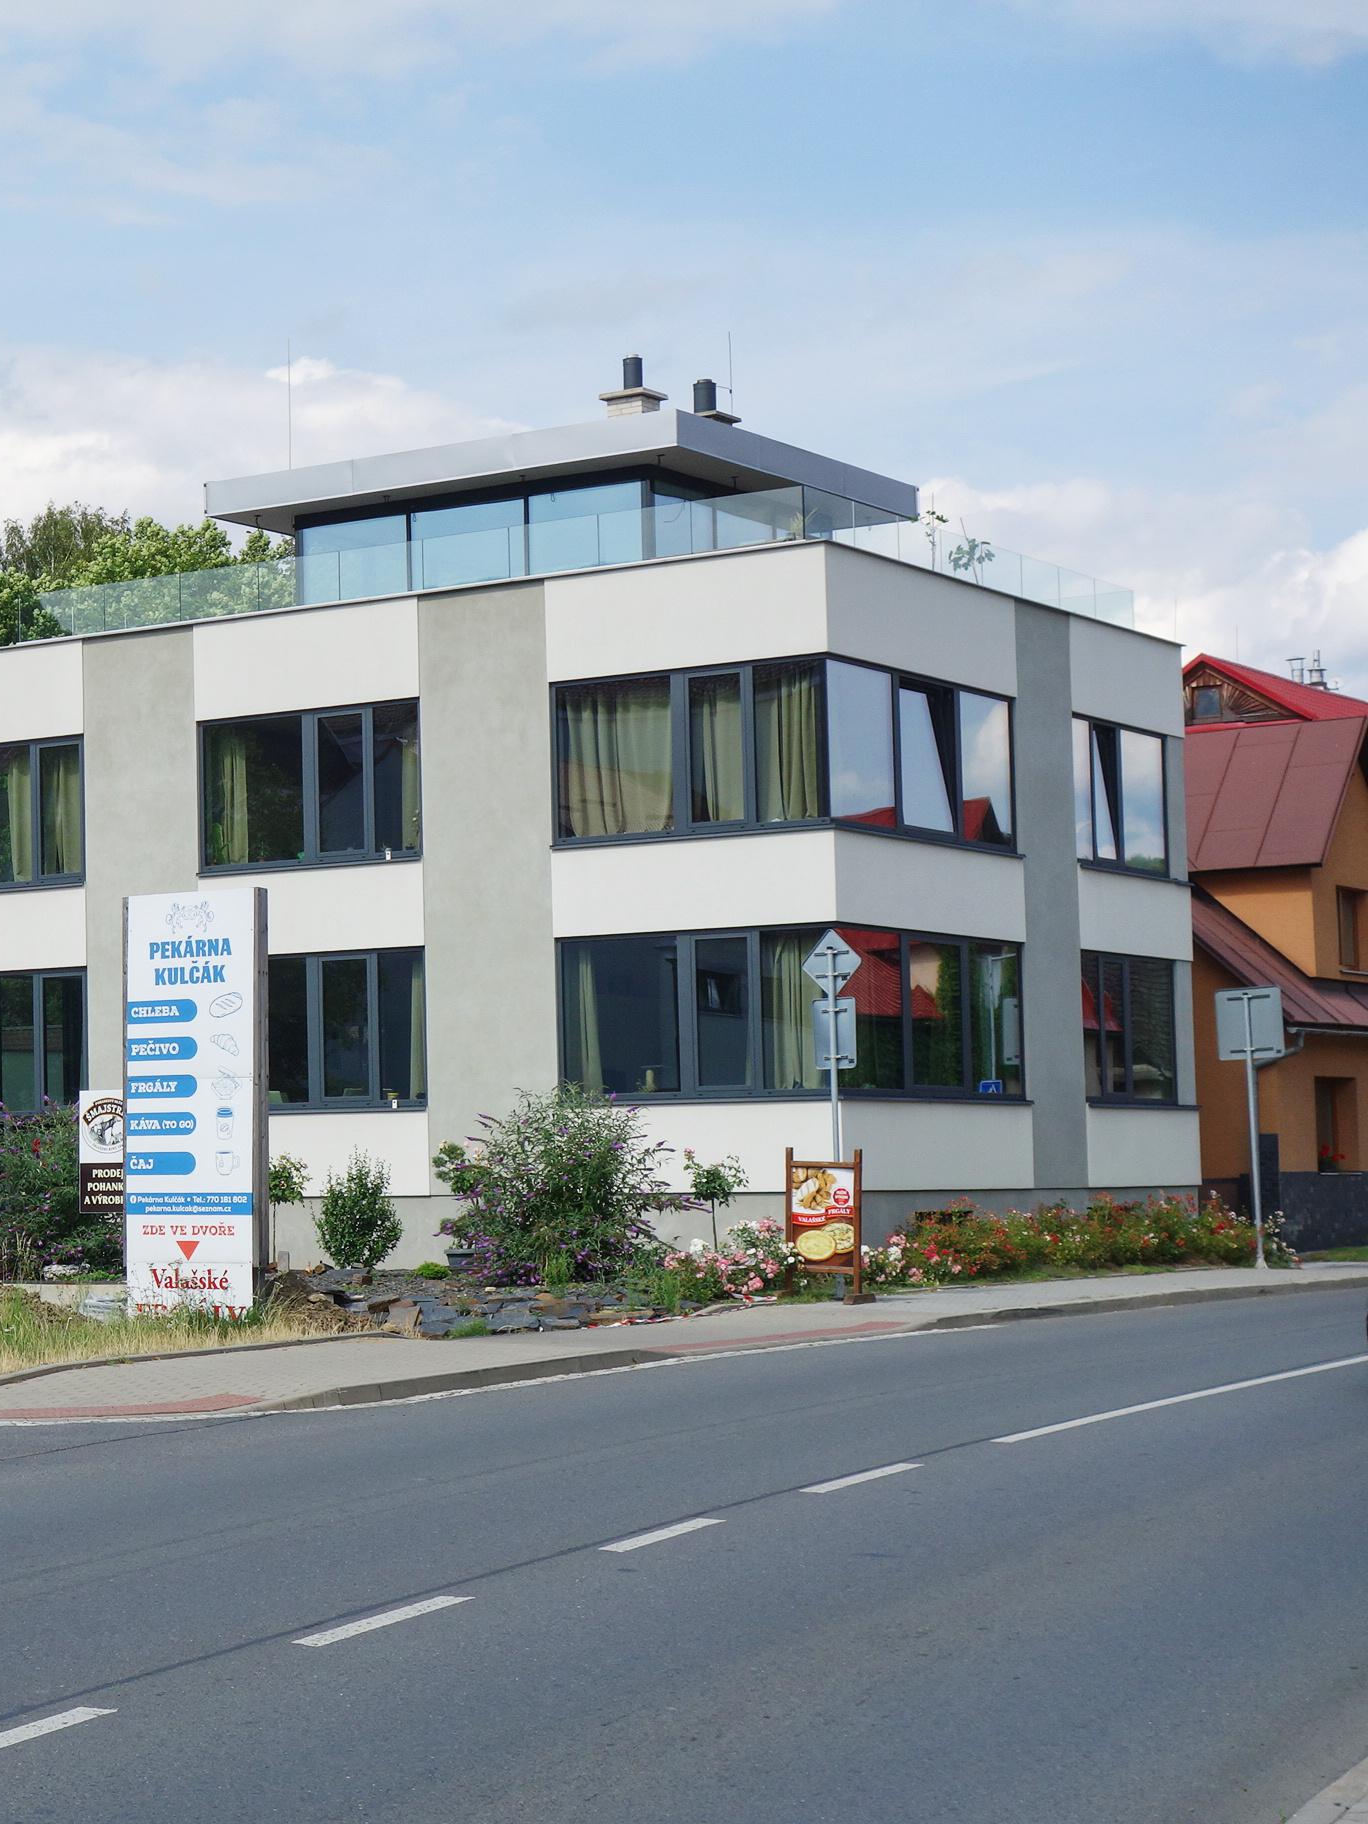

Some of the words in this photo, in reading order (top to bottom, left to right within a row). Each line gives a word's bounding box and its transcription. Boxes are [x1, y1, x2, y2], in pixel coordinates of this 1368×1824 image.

[149, 936, 232, 960] PEKÁRNA
[154, 961, 225, 986] KULČÁK
[131, 1005, 179, 1018] CHLEBA
[131, 1040, 179, 1056] PEČIVO
[131, 1079, 177, 1093] FRGÁLY
[130, 1117, 161, 1130] KÁVA
[161, 1119, 177, 1130] (TO
[178, 1119, 194, 1130] GO)
[130, 1157, 154, 1169] ČAJ
[92, 1169, 124, 1180] PRODEJ
[87, 1182, 124, 1191] POHANK
[83, 1195, 91, 1205] A
[137, 1195, 163, 1204] Pekárna
[207, 1195, 219, 1203] 770
[142, 1225, 166, 1236] ZDE
[170, 1225, 187, 1236] VE
[191, 1220, 235, 1236] DVOŘE
[150, 1267, 229, 1290] Valašské
